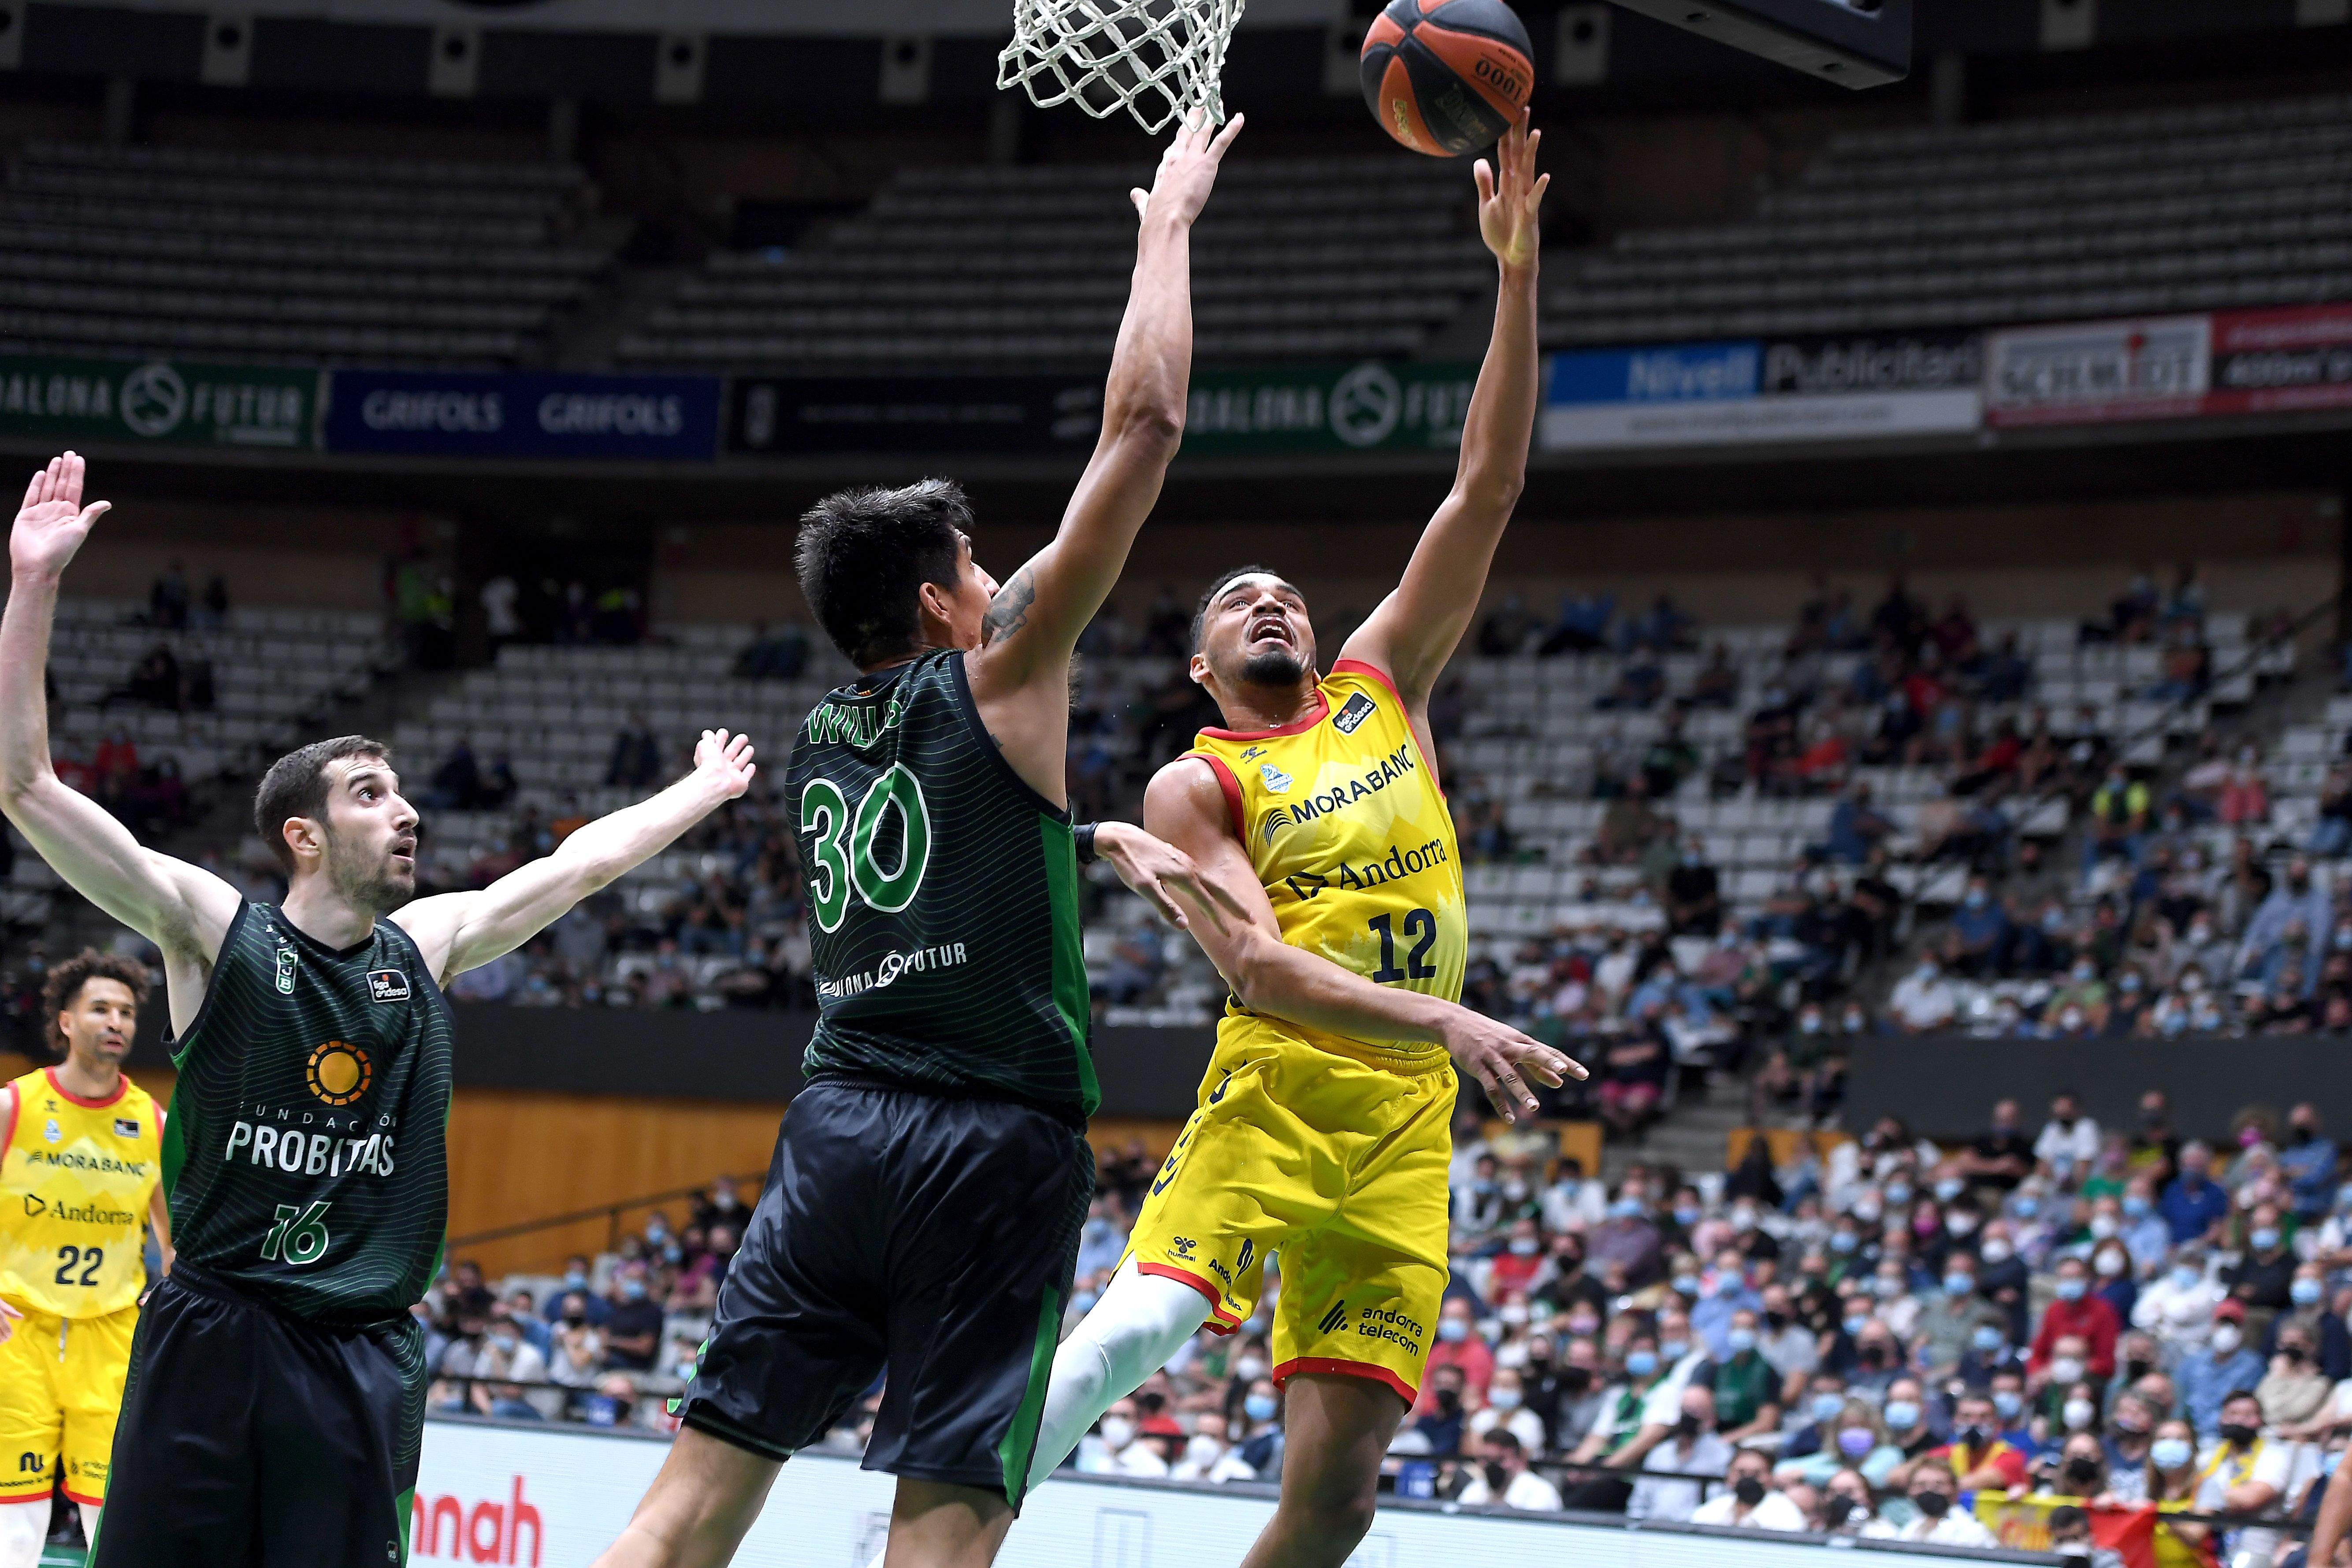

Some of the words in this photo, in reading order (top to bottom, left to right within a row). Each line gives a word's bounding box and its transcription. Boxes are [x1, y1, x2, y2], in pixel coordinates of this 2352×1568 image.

[1475, 59, 1523, 102] 1000
[192, 383, 302, 426] FUTUR
[362, 390, 505, 432] GRIFOLS
[538, 392, 683, 436] GRIFOLS
[1337, 713, 1352, 728] liga
[1345, 702, 1372, 731] endesa
[1290, 744, 1414, 824] MORABANC
[801, 761, 932, 933] 30
[1338, 838, 1447, 891] Andorra
[904, 943, 966, 974] FUTUR
[1367, 908, 1437, 983] 12
[373, 980, 389, 990] liga
[375, 987, 407, 998] endesa
[48, 1152, 147, 1177] MORABANC
[225, 1121, 394, 1177] PROBITAS
[49, 1200, 134, 1226] Andorra
[260, 1200, 332, 1265] 16
[55, 1245, 104, 1286] 22
[1168, 1249, 1196, 1262] hummel
[1359, 1323, 1418, 1356] telecom
[1362, 1308, 1423, 1338] andorra
